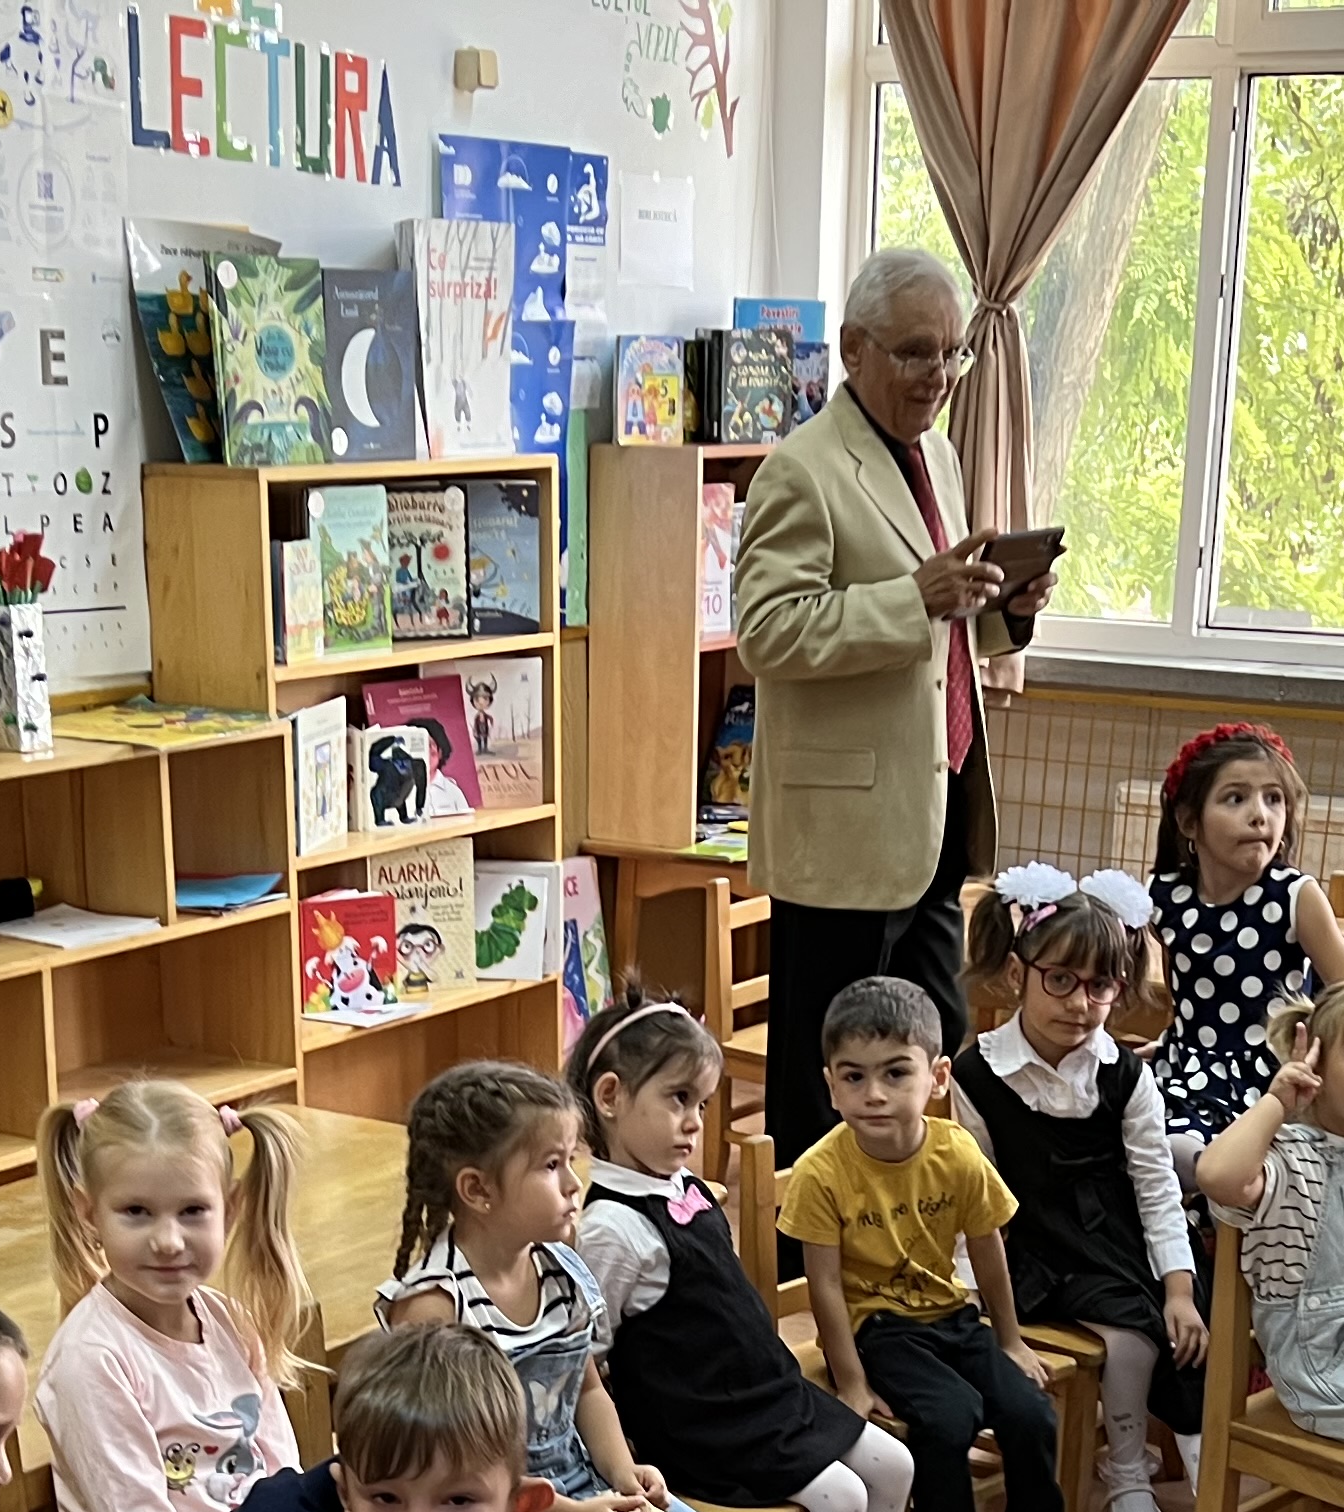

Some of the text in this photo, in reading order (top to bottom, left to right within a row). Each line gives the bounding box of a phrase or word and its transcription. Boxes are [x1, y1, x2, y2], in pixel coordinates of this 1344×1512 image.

[126, 8, 402, 188] LECTURA
[40, 329, 68, 385] E
[0, 412, 109, 449] S P
[1, 472, 112, 497] T O Z
[73, 513, 83, 533] E
[102, 512, 115, 533] A
